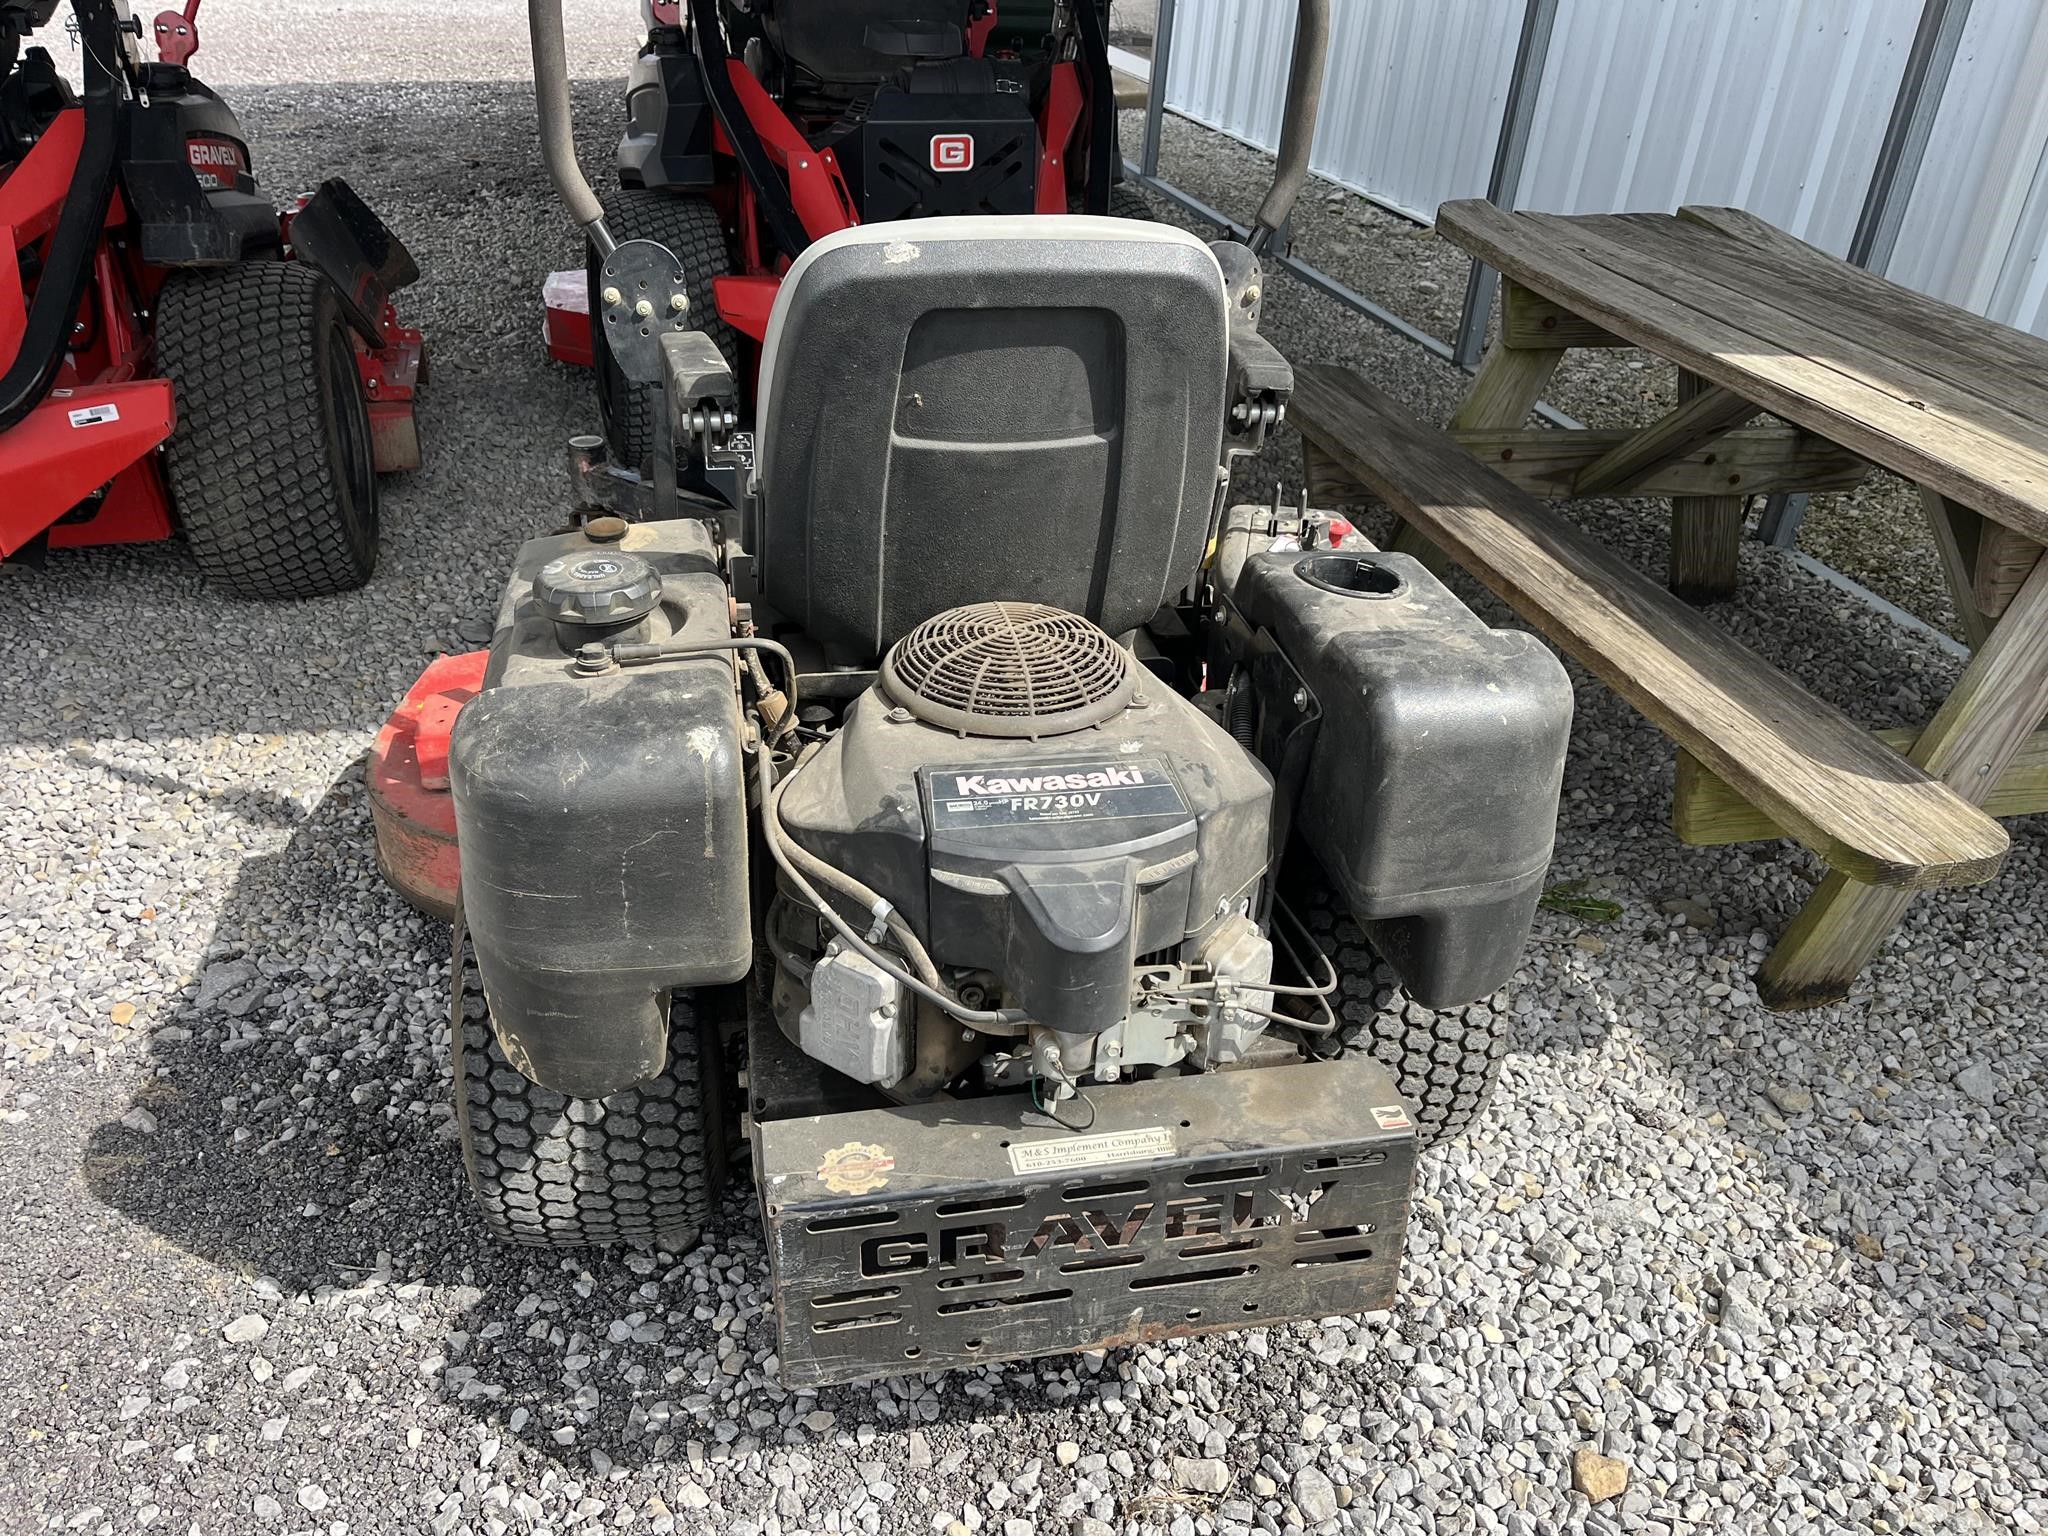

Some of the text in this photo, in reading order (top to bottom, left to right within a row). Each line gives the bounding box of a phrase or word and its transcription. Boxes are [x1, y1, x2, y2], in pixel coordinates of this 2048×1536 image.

[189, 144, 237, 166] GRAVELY
[955, 766, 1145, 796] Kawasaki
[1011, 793, 1102, 812] FR730V
[1052, 1141, 1108, 1156] Implement
[1111, 1134, 1163, 1149] Company
[860, 1179, 1339, 1279] GRAVELY
